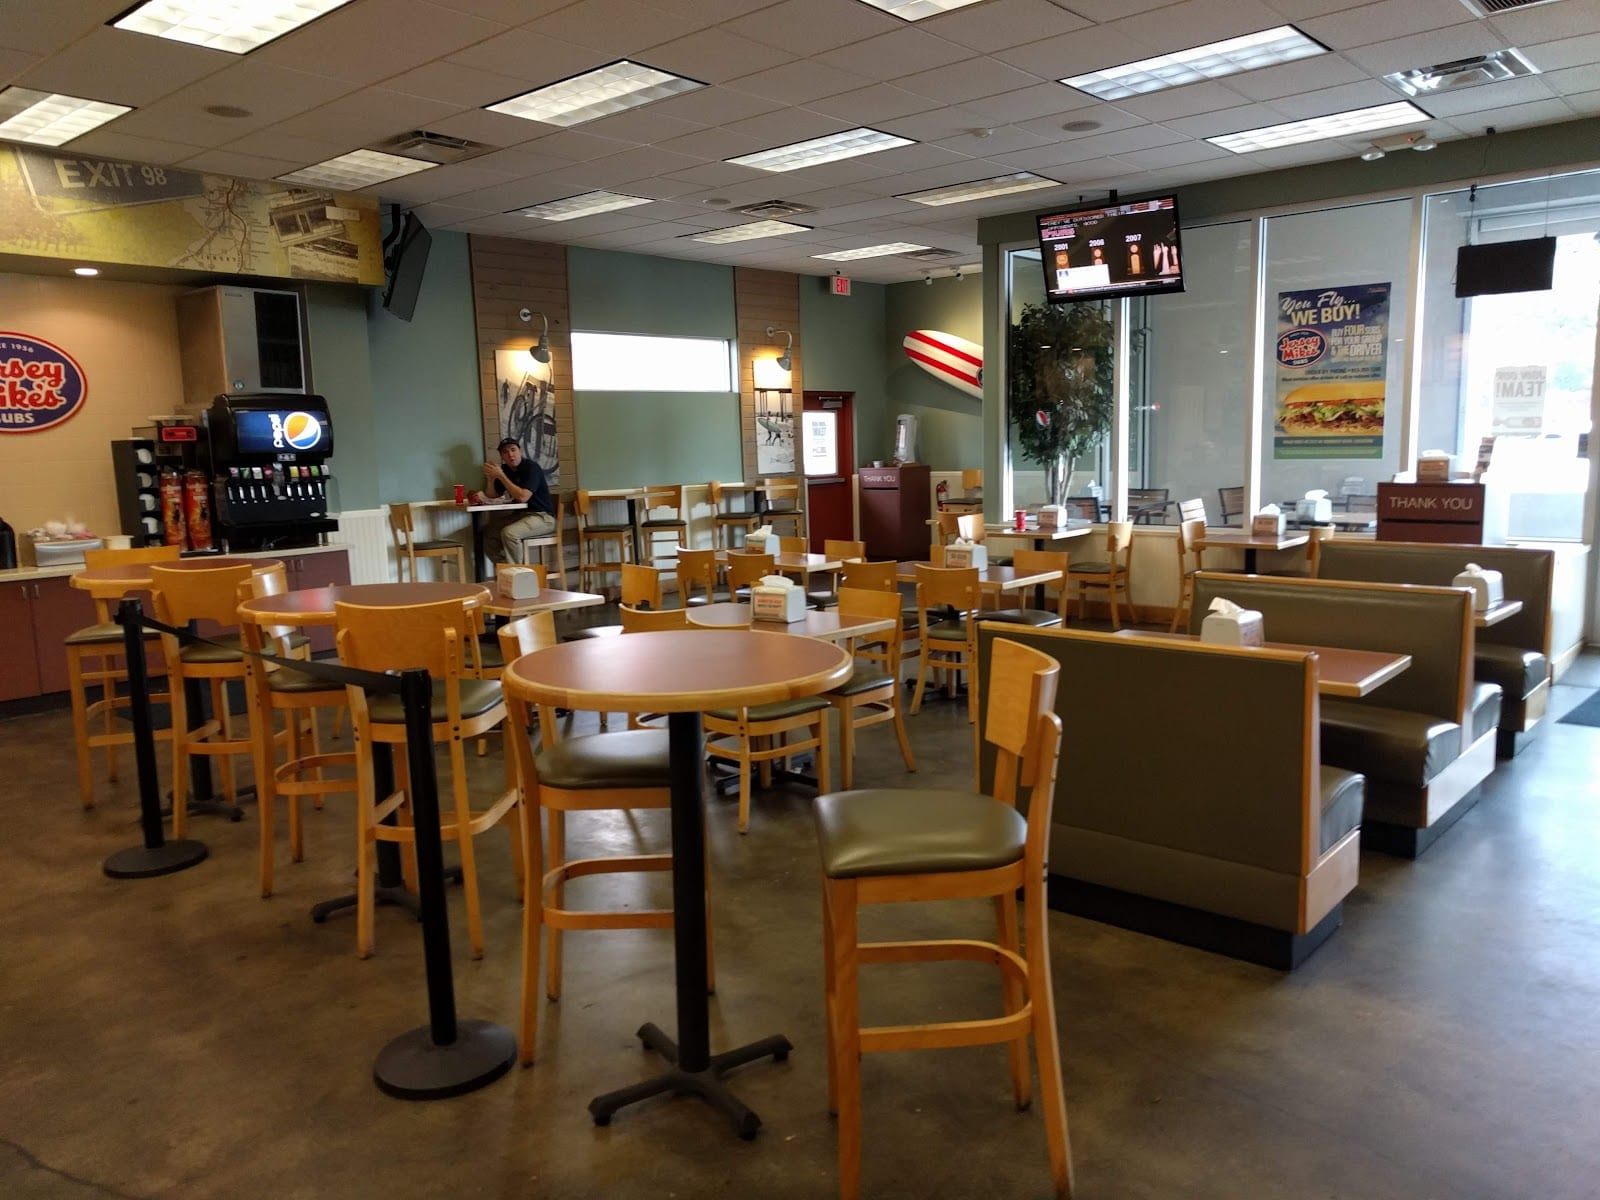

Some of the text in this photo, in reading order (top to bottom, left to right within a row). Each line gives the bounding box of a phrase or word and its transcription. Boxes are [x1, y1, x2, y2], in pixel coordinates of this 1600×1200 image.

[54, 160, 167, 188] EXIT 98
[1125, 234, 1142, 243] 2007
[1280, 297, 1312, 315] You
[1291, 303, 1360, 327] WE BUY!
[1343, 324, 1365, 336] FOUR
[1279, 336, 1320, 351] Jersey
[1350, 343, 1383, 356] DRIVER
[0, 412, 34, 424] UBS
[883, 474, 896, 482] YOU
[1388, 496, 1473, 510] THANK YOU
